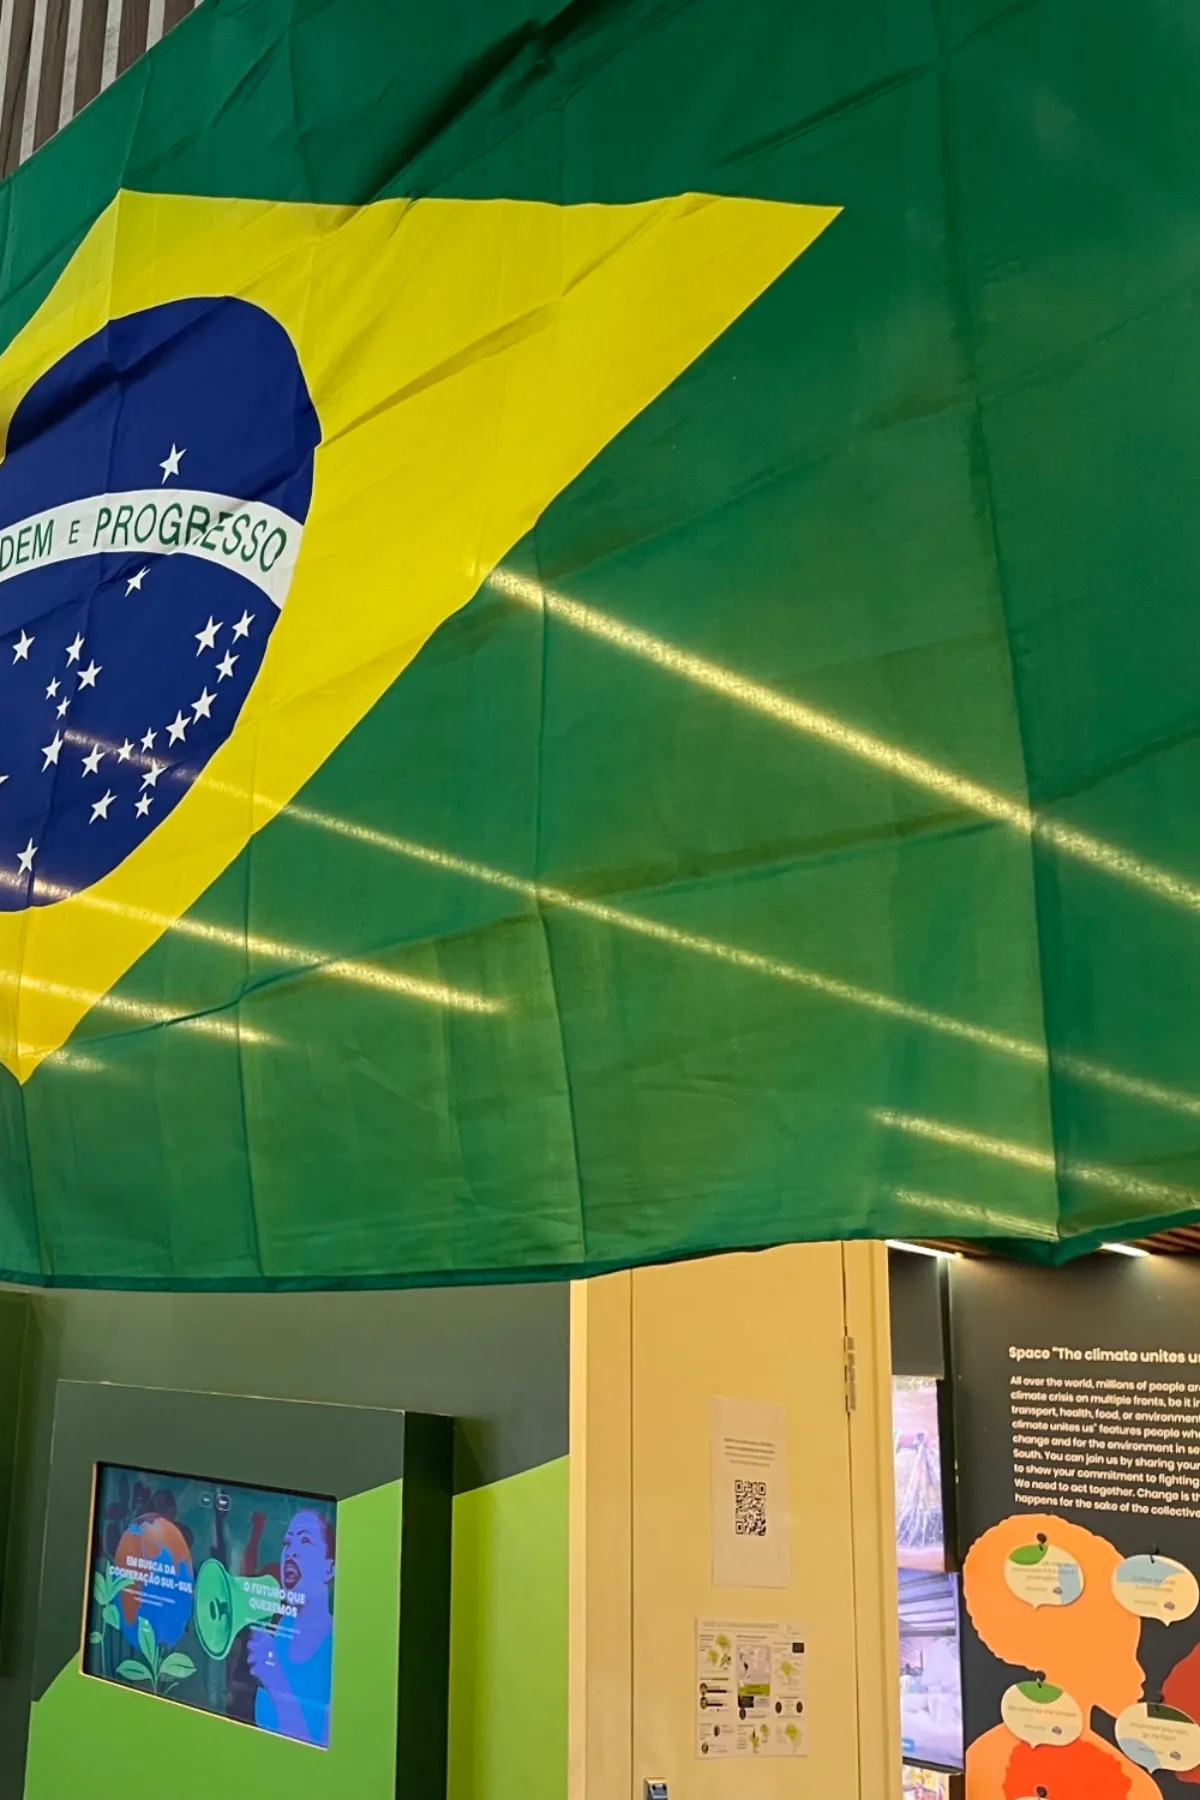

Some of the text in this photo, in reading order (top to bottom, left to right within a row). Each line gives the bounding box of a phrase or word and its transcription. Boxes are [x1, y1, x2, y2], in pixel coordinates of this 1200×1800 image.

[68, 520, 81, 545] E
[92, 503, 288, 573] PROGRESSO
[1009, 1347, 1050, 1364] Space
[1053, 1346, 1083, 1361] "The
[1085, 1347, 1139, 1362] climate
[1141, 1349, 1185, 1363] unites
[1010, 1376, 1021, 1385] All
[1023, 1378, 1044, 1386] over
[1046, 1377, 1062, 1387] the
[1096, 1379, 1136, 1390] millions
[1138, 1380, 1148, 1390] of
[1150, 1382, 1185, 1394] people
[1187, 1384, 1200, 1392] ar
[1010, 1390, 1046, 1401] climate
[1048, 1392, 1073, 1402] crisis
[1075, 1395, 1088, 1403] on
[1090, 1394, 1131, 1407] multiple
[1167, 1397, 1181, 1406] be
[1183, 1397, 1190, 1407] it
[1012, 1420, 1048, 1431] climate
[1050, 1422, 1080, 1433] unites
[1100, 1424, 1142, 1436] features
[1144, 1428, 1180, 1439] people
[1013, 1434, 1049, 1447] change
[1051, 1437, 1071, 1446] and
[1073, 1437, 1087, 1447] for
[1089, 1439, 1106, 1448] the
[1108, 1440, 1173, 1452] environment
[1175, 1443, 1185, 1453] in
[1045, 1451, 1063, 1461] You
[1065, 1454, 1084, 1462] can
[1086, 1453, 1104, 1465] join
[1120, 1455, 1133, 1468] by
[1135, 1457, 1175, 1471] sharing
[1014, 1464, 1200, 1488] to show your commitment to fighting
[1015, 1479, 1029, 1488] We
[1031, 1481, 1056, 1490] need
[1058, 1482, 1068, 1491] to
[1070, 1483, 1087, 1492] act
[1137, 1487, 1178, 1501] Change
[1180, 1489, 1189, 1499] is
[1015, 1493, 1057, 1506] happens
[1059, 1496, 1073, 1507] for
[1075, 1498, 1091, 1508] the
[1093, 1500, 1117, 1510] sake
[1119, 1501, 1130, 1511] of
[1132, 1503, 1149, 1513] the
[138, 1557, 164, 1573] BUSCA
[164, 1564, 176, 1576] DA
[109, 1565, 193, 1594] COOPERAÇÃO SUL-SUL
[243, 1581, 306, 1605] O FUTURO QUE
[249, 1597, 298, 1619] QUEREMOS
